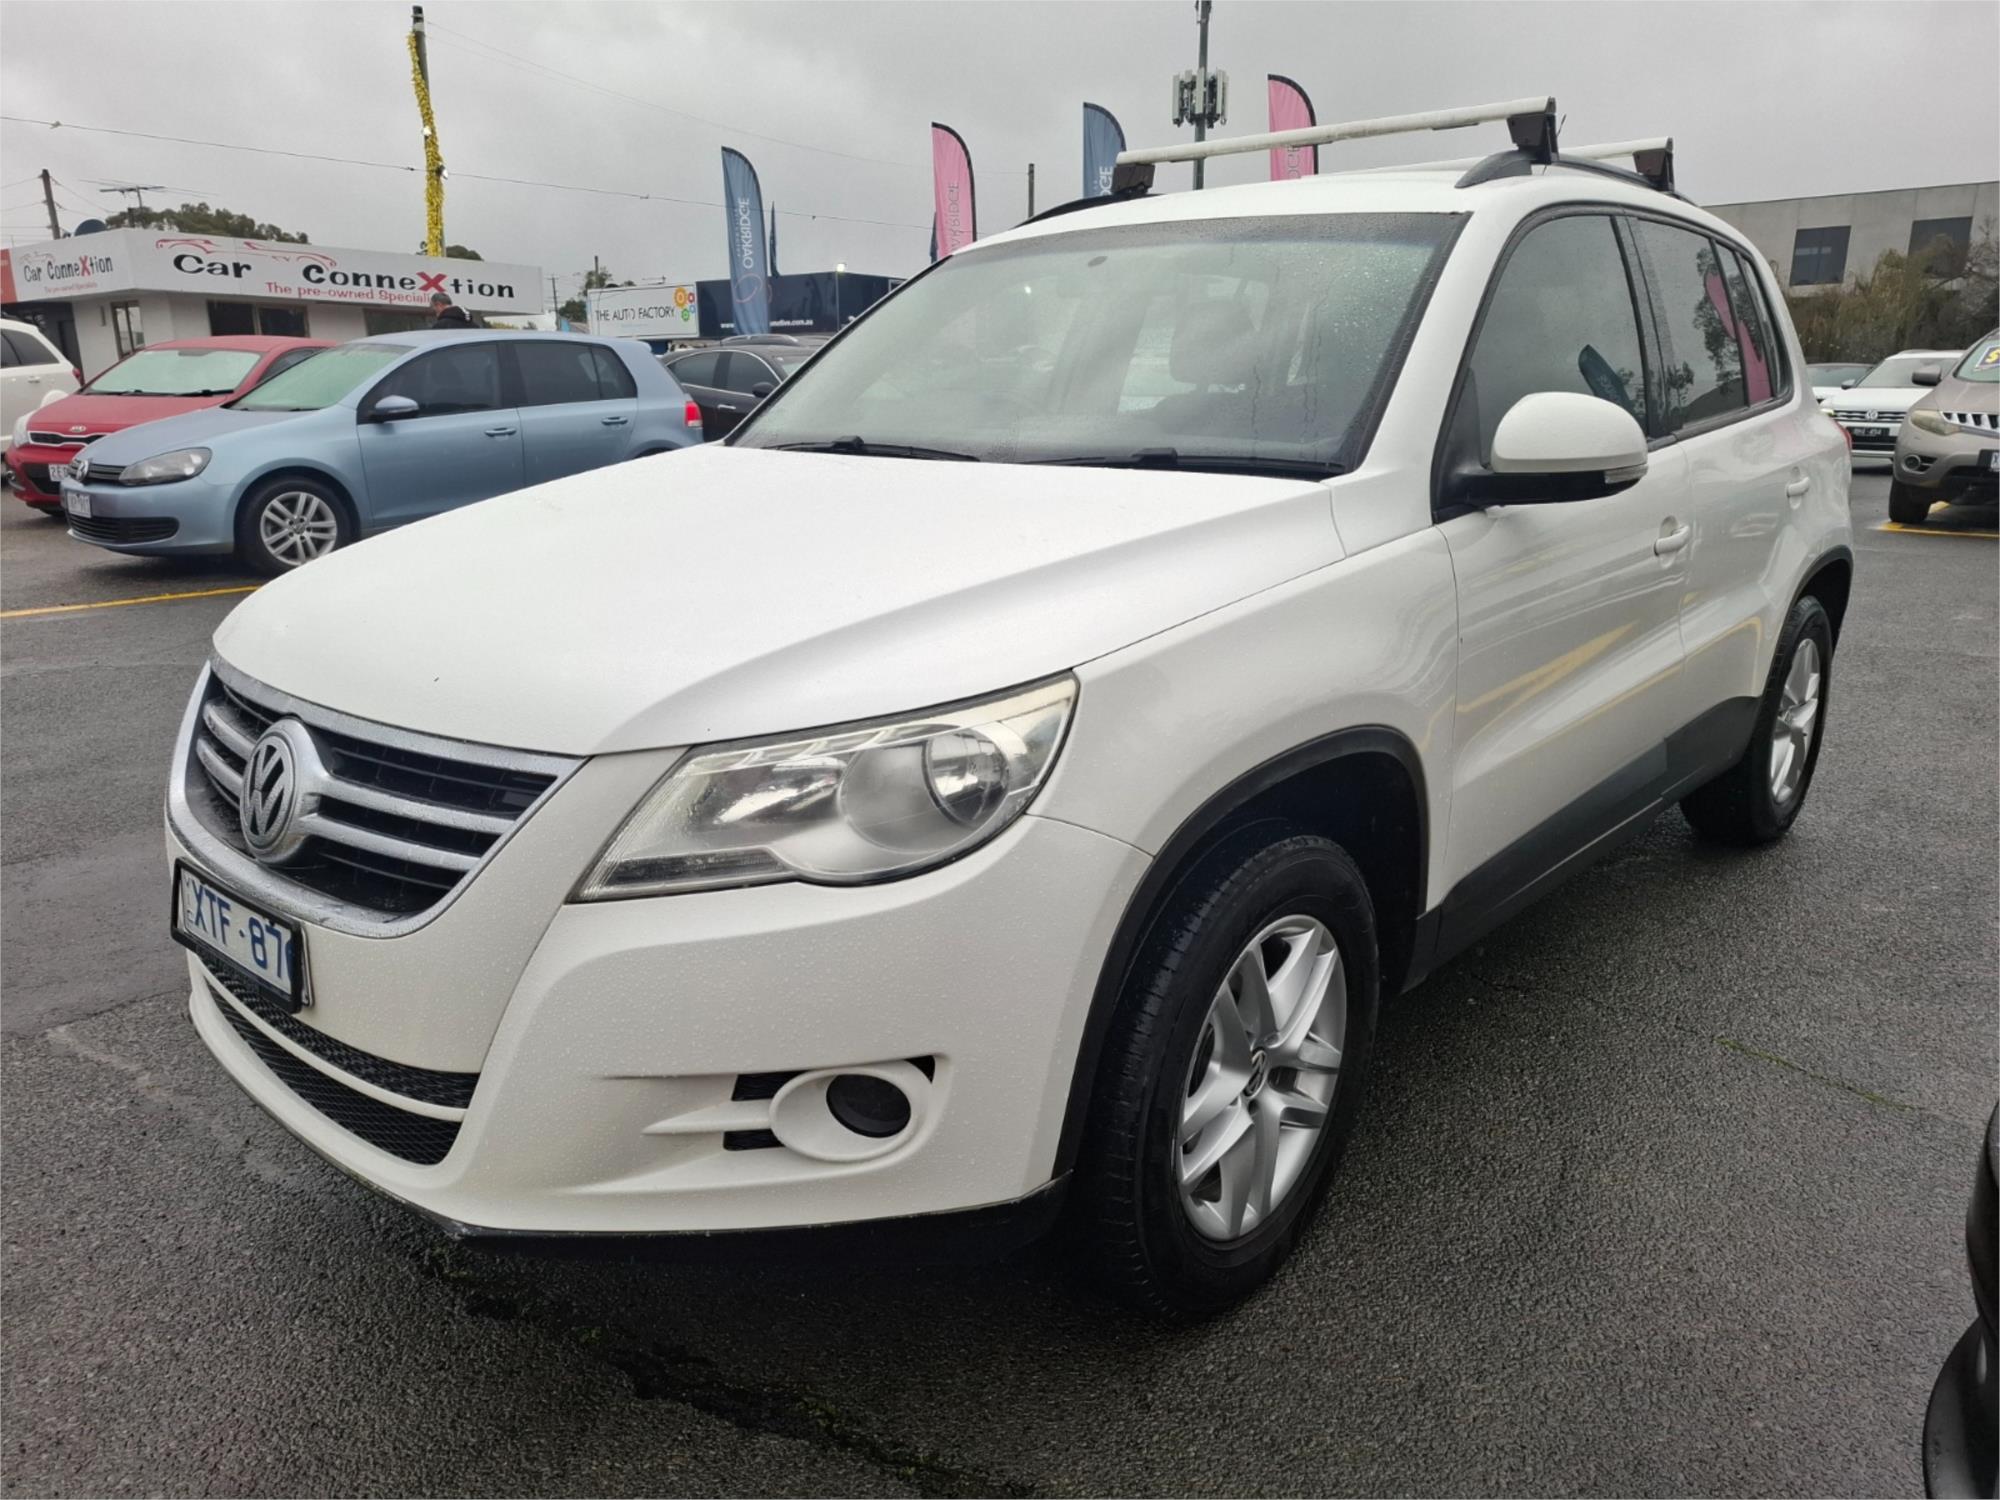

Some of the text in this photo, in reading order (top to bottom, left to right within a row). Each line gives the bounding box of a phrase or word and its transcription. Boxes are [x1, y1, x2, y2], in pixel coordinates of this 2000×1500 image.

[24, 255, 113, 282] Car ConneXtion
[173, 254, 515, 298] Car ConneXtion
[265, 282, 431, 304] The pre-owned Speciali
[595, 309, 610, 321] THE
[638, 305, 675, 319] FACTORY
